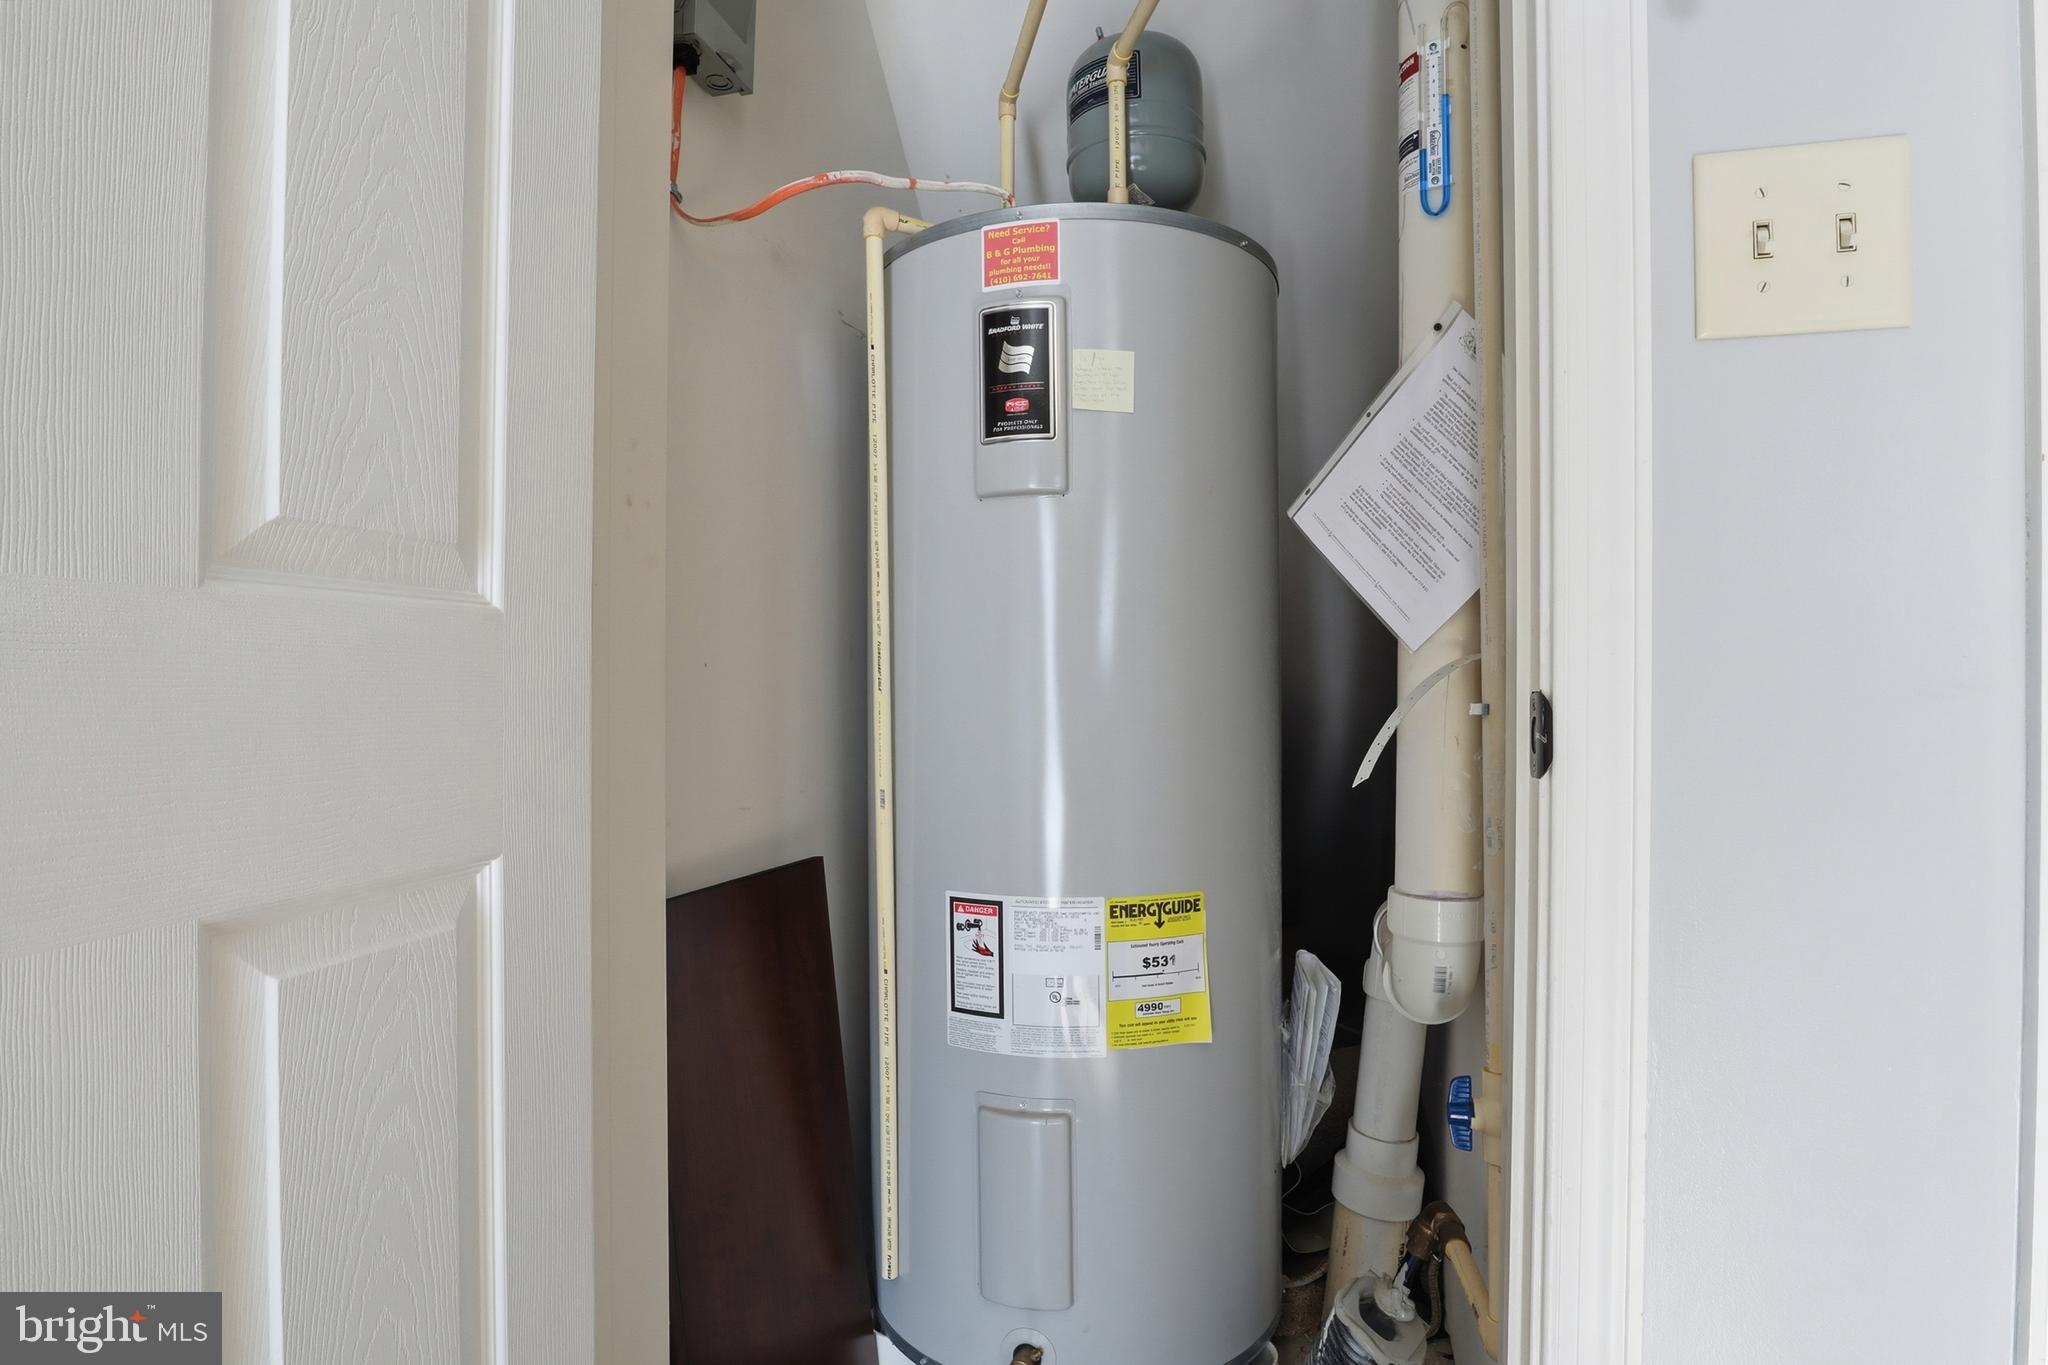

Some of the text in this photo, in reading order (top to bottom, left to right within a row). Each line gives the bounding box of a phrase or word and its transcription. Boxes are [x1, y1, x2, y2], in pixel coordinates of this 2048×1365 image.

[988, 224, 1050, 239] Need Service?
[986, 250, 993, 259] B
[1003, 248, 1010, 256] G
[1012, 244, 1055, 255] Plumbing
[1012, 256, 1021, 264] all
[988, 266, 1022, 277] plumbing
[990, 275, 1011, 286] (410)
[988, 325, 1021, 335] BRADFORD
[965, 905, 994, 915] DANGER
[1109, 898, 1201, 922] ENERGYGUIDE
[1137, 1002, 1163, 1012] 4990
